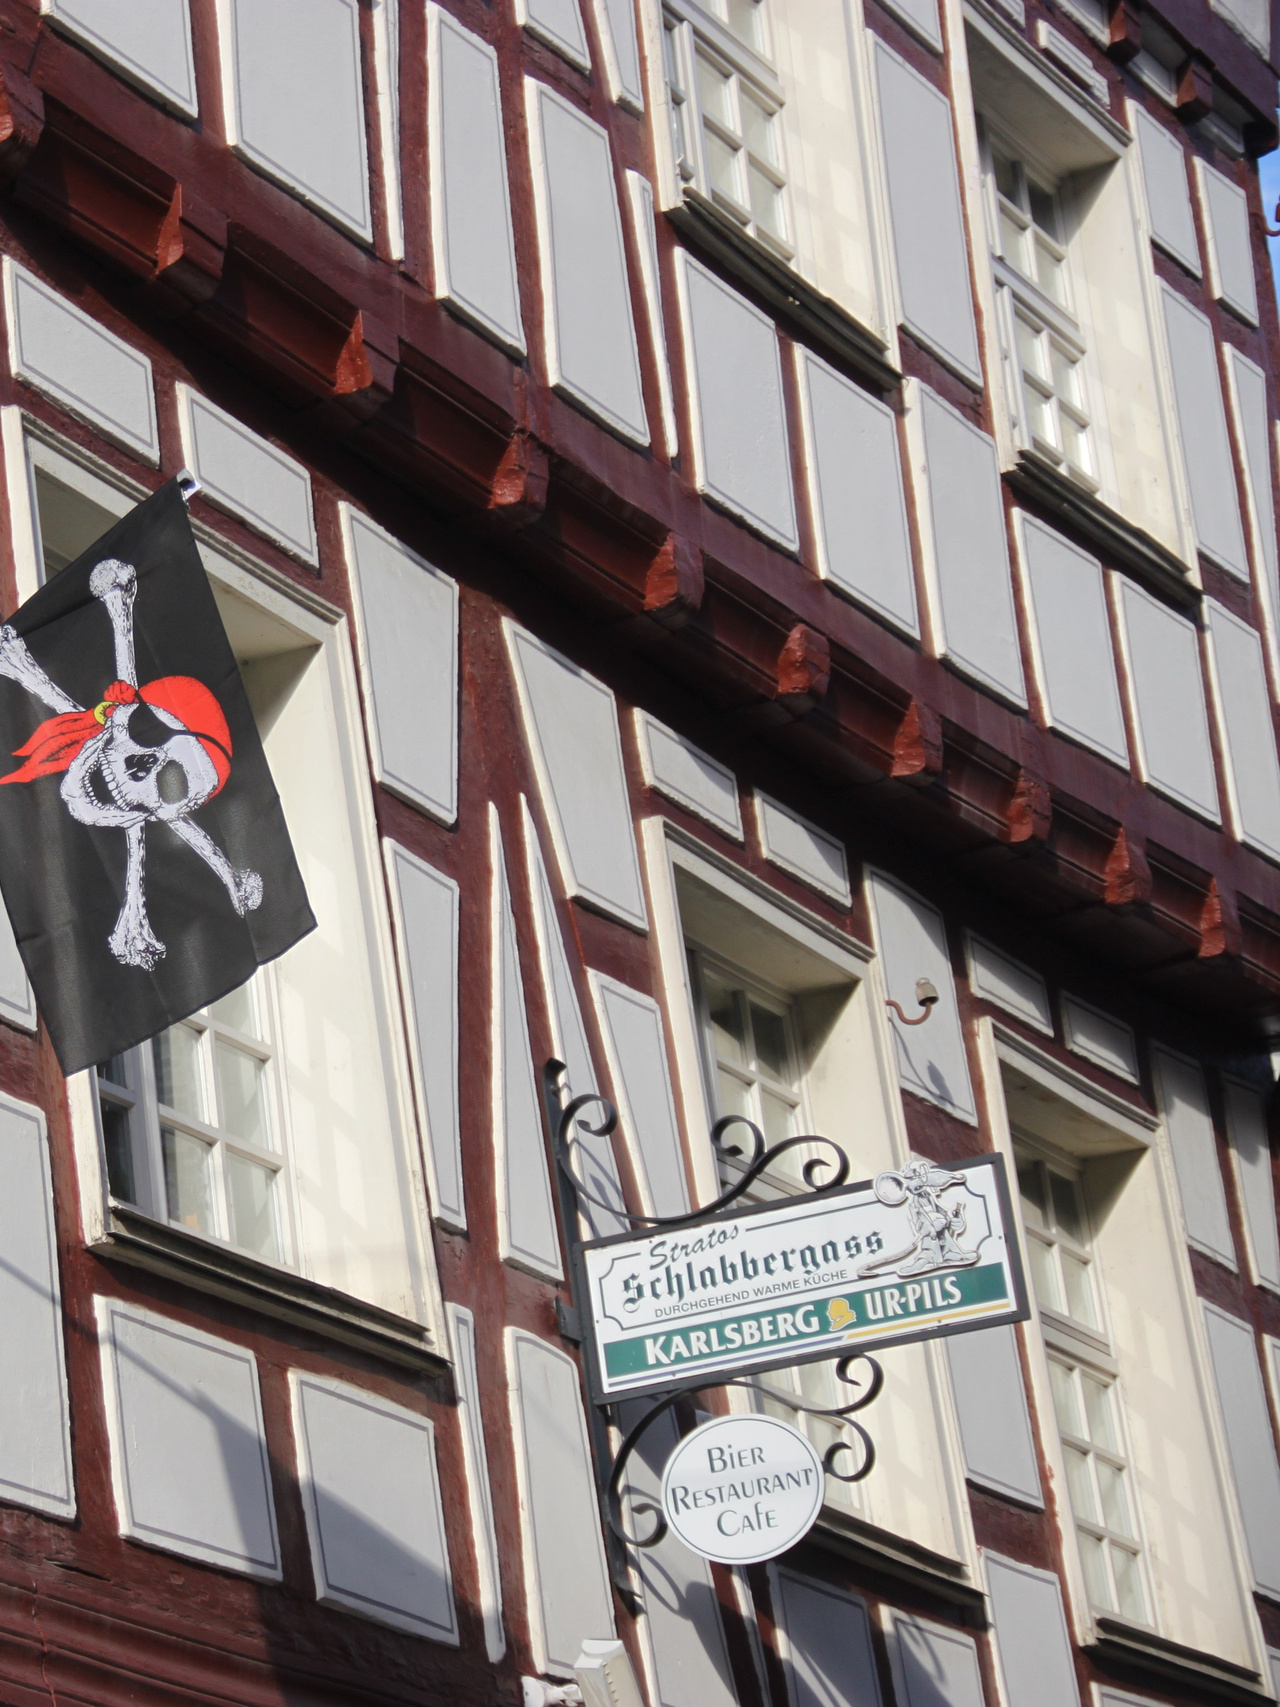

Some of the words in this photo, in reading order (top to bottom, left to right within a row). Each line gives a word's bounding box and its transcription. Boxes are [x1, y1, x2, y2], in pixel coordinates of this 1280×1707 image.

[622, 1230, 886, 1313] Schlabbergass
[649, 1223, 740, 1271] Stratos
[654, 1289, 751, 1318] DURCHGEHEND
[752, 1280, 801, 1299] WARME
[804, 1268, 848, 1288] KÜCHE
[644, 1304, 820, 1366] KARLSBERG
[864, 1276, 962, 1321] UR-PILS
[671, 1468, 813, 1516] RESTAURANT
